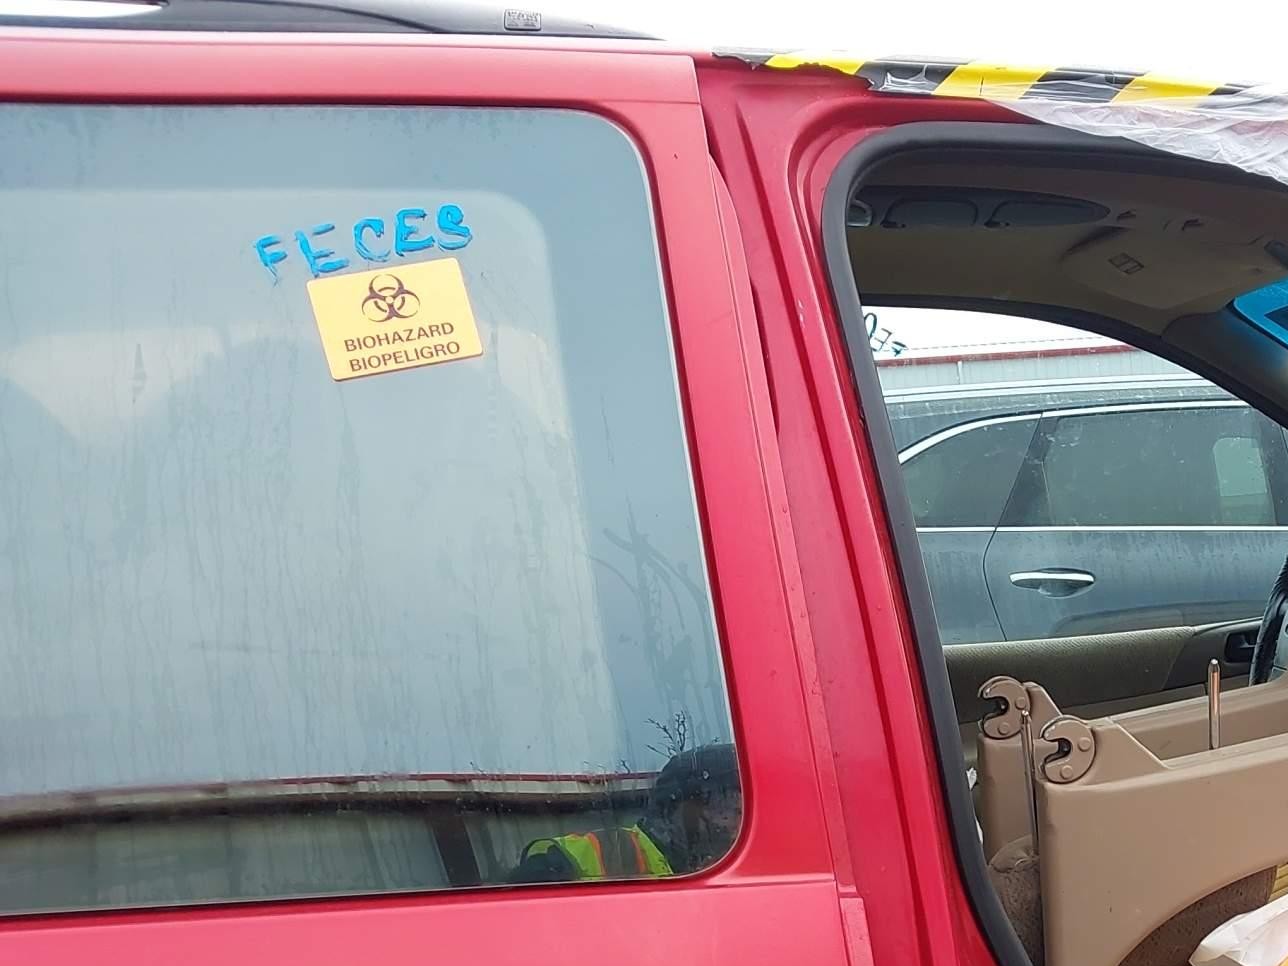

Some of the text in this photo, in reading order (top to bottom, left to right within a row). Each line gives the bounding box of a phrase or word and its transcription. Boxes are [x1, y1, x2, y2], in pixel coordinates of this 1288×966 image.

[254, 204, 472, 286] FECES
[344, 322, 455, 353] BIOHAZARD
[349, 341, 461, 372] BIOPELIGRO
